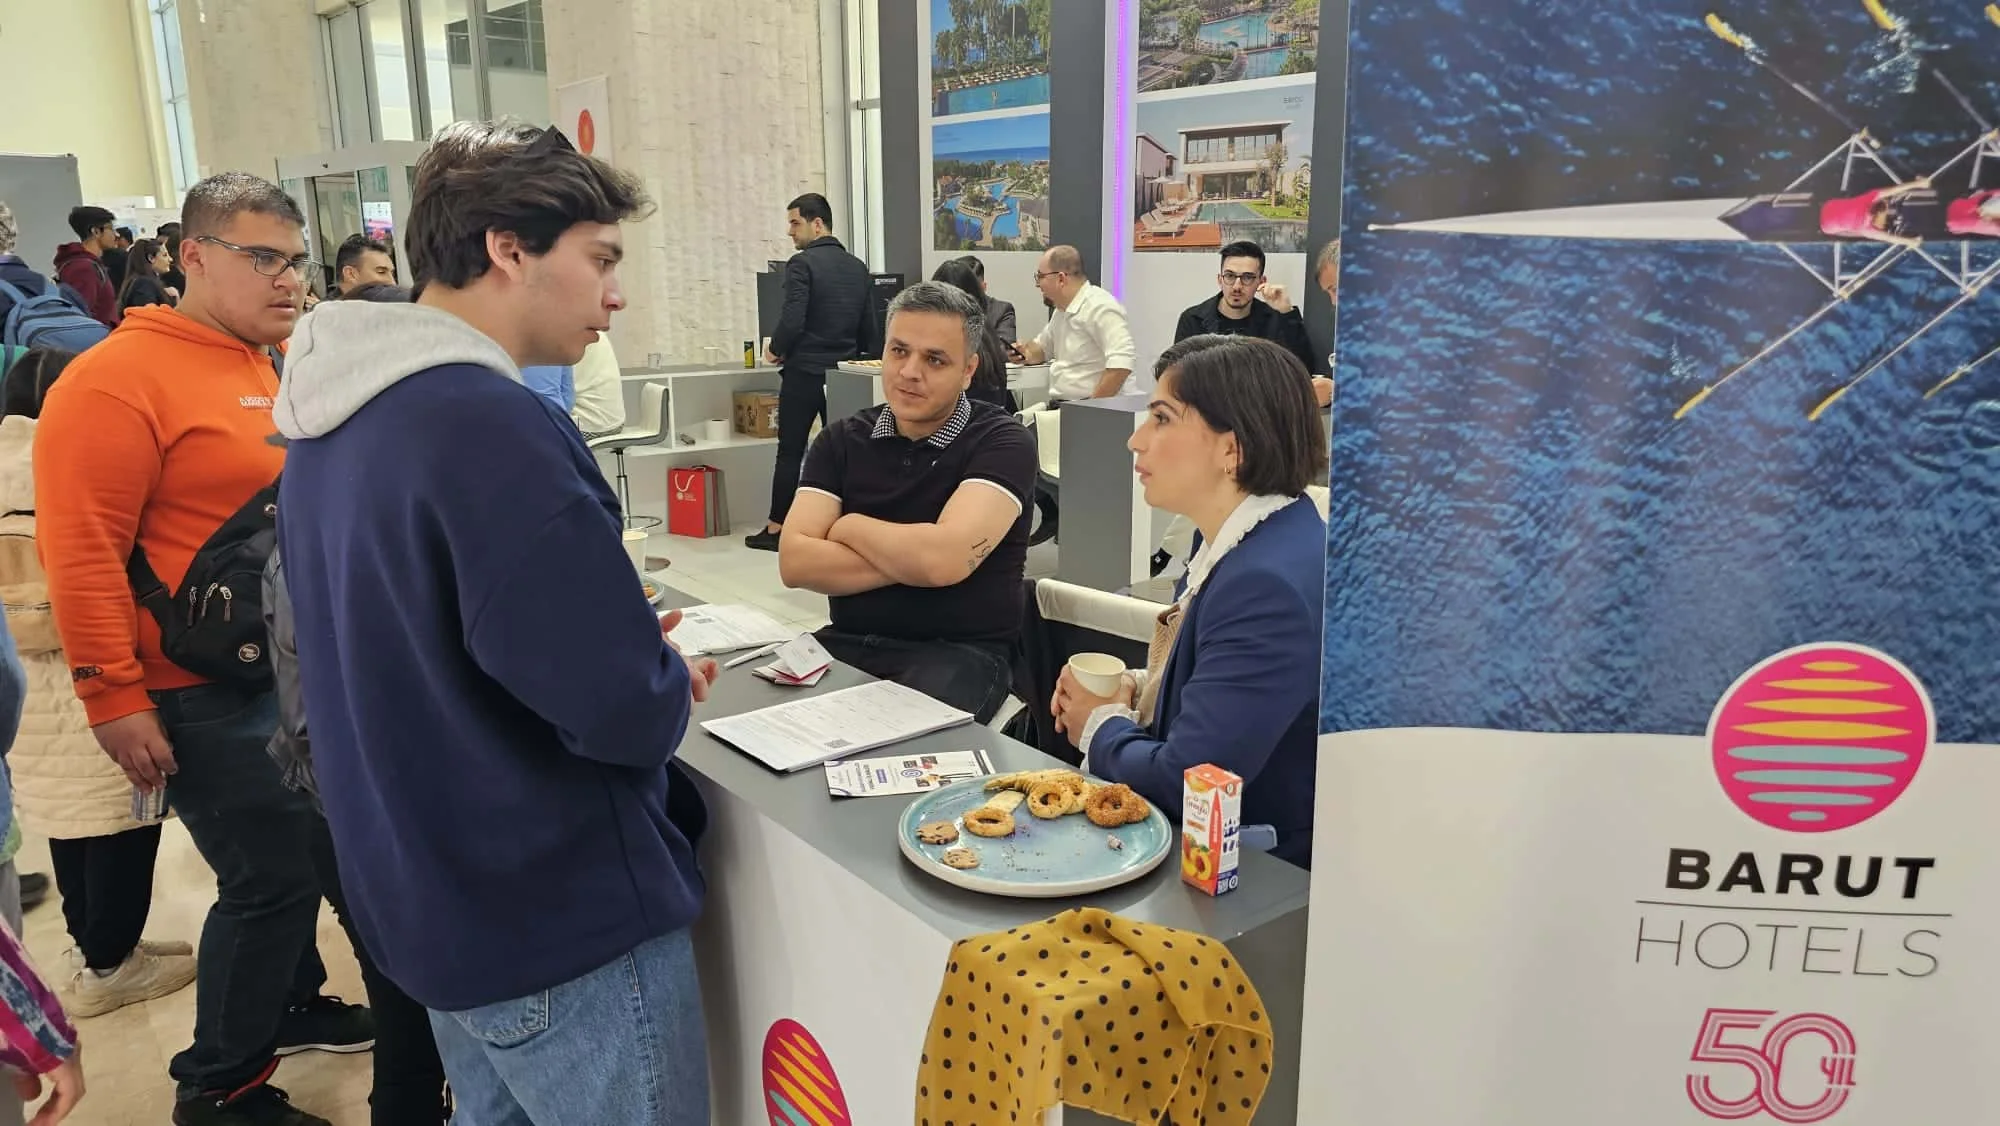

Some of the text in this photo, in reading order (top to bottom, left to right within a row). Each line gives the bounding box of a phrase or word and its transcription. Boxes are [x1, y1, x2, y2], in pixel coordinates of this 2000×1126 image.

[1665, 848, 1936, 899] BARUT
[1635, 916, 1942, 978] HOTELS
[1686, 1007, 1857, 1124] 50
